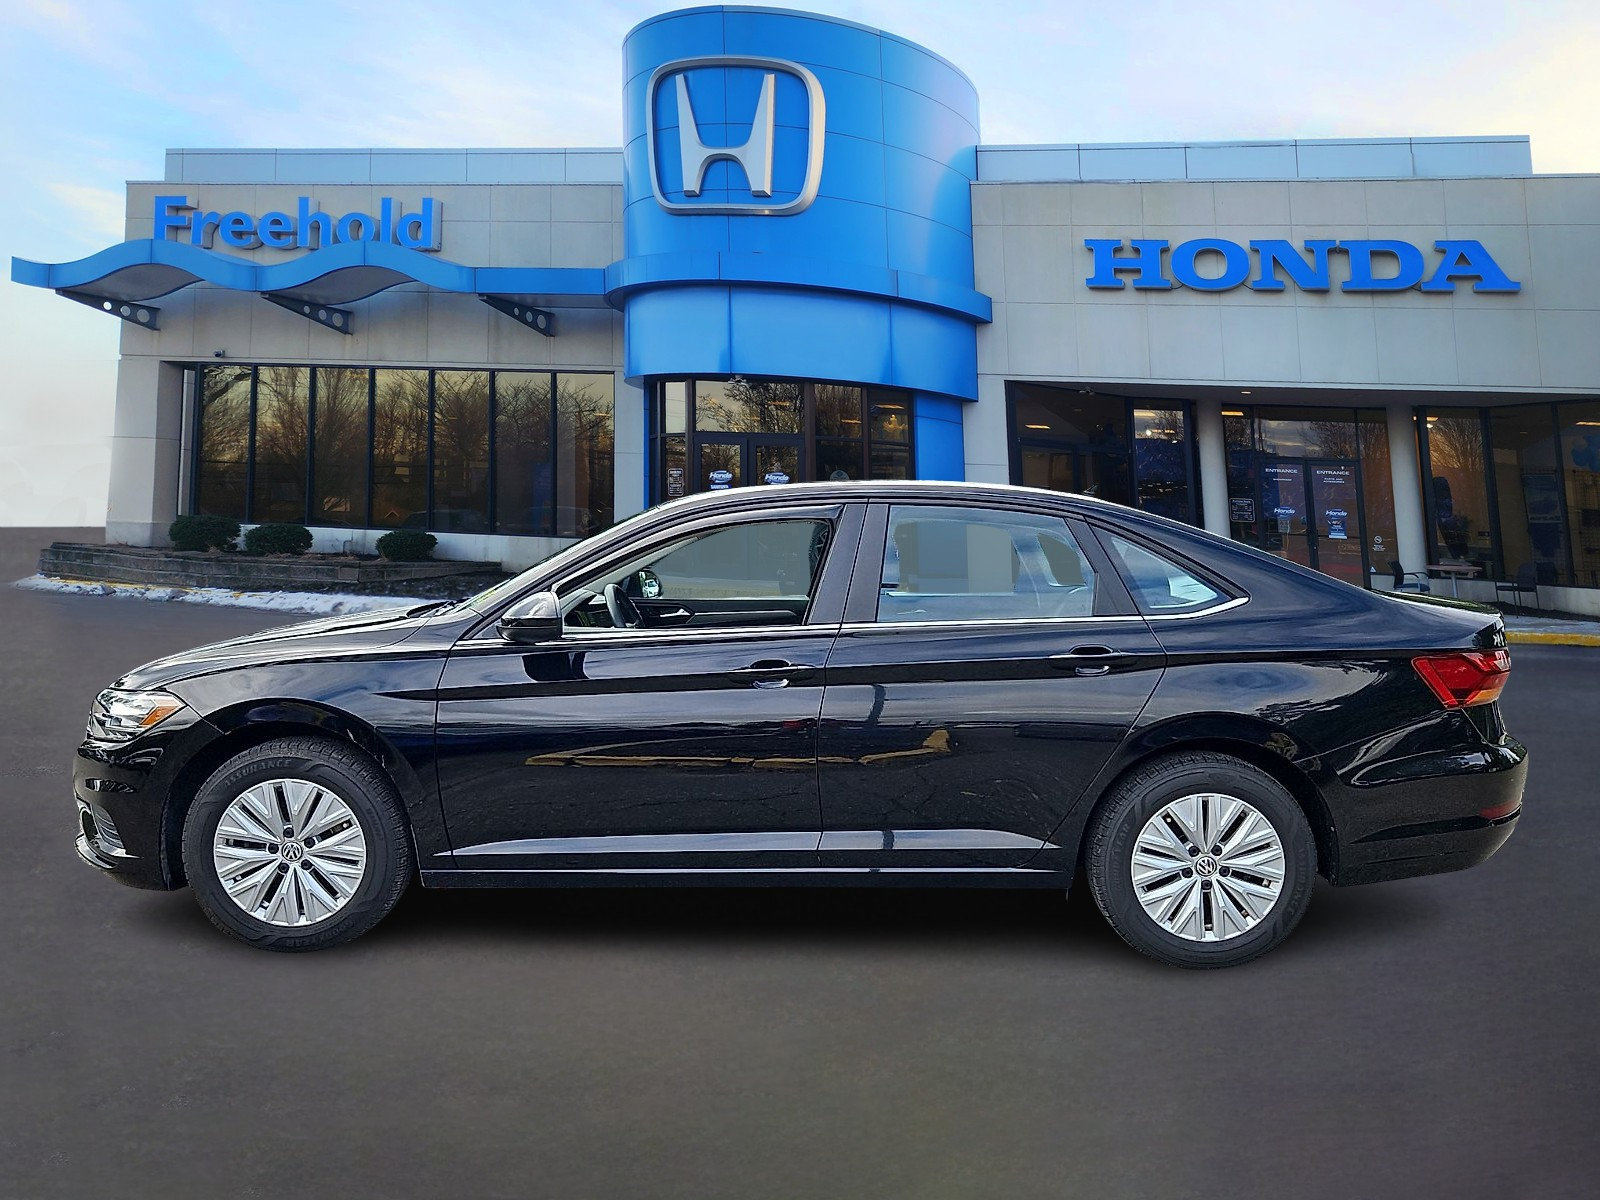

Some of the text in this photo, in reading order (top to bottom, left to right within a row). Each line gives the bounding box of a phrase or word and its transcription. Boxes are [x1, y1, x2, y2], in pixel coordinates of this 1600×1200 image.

[154, 196, 439, 248] Freehold
[1084, 238, 1521, 292] HONDA
[709, 472, 733, 480] Honda
[764, 474, 790, 482] Honda
